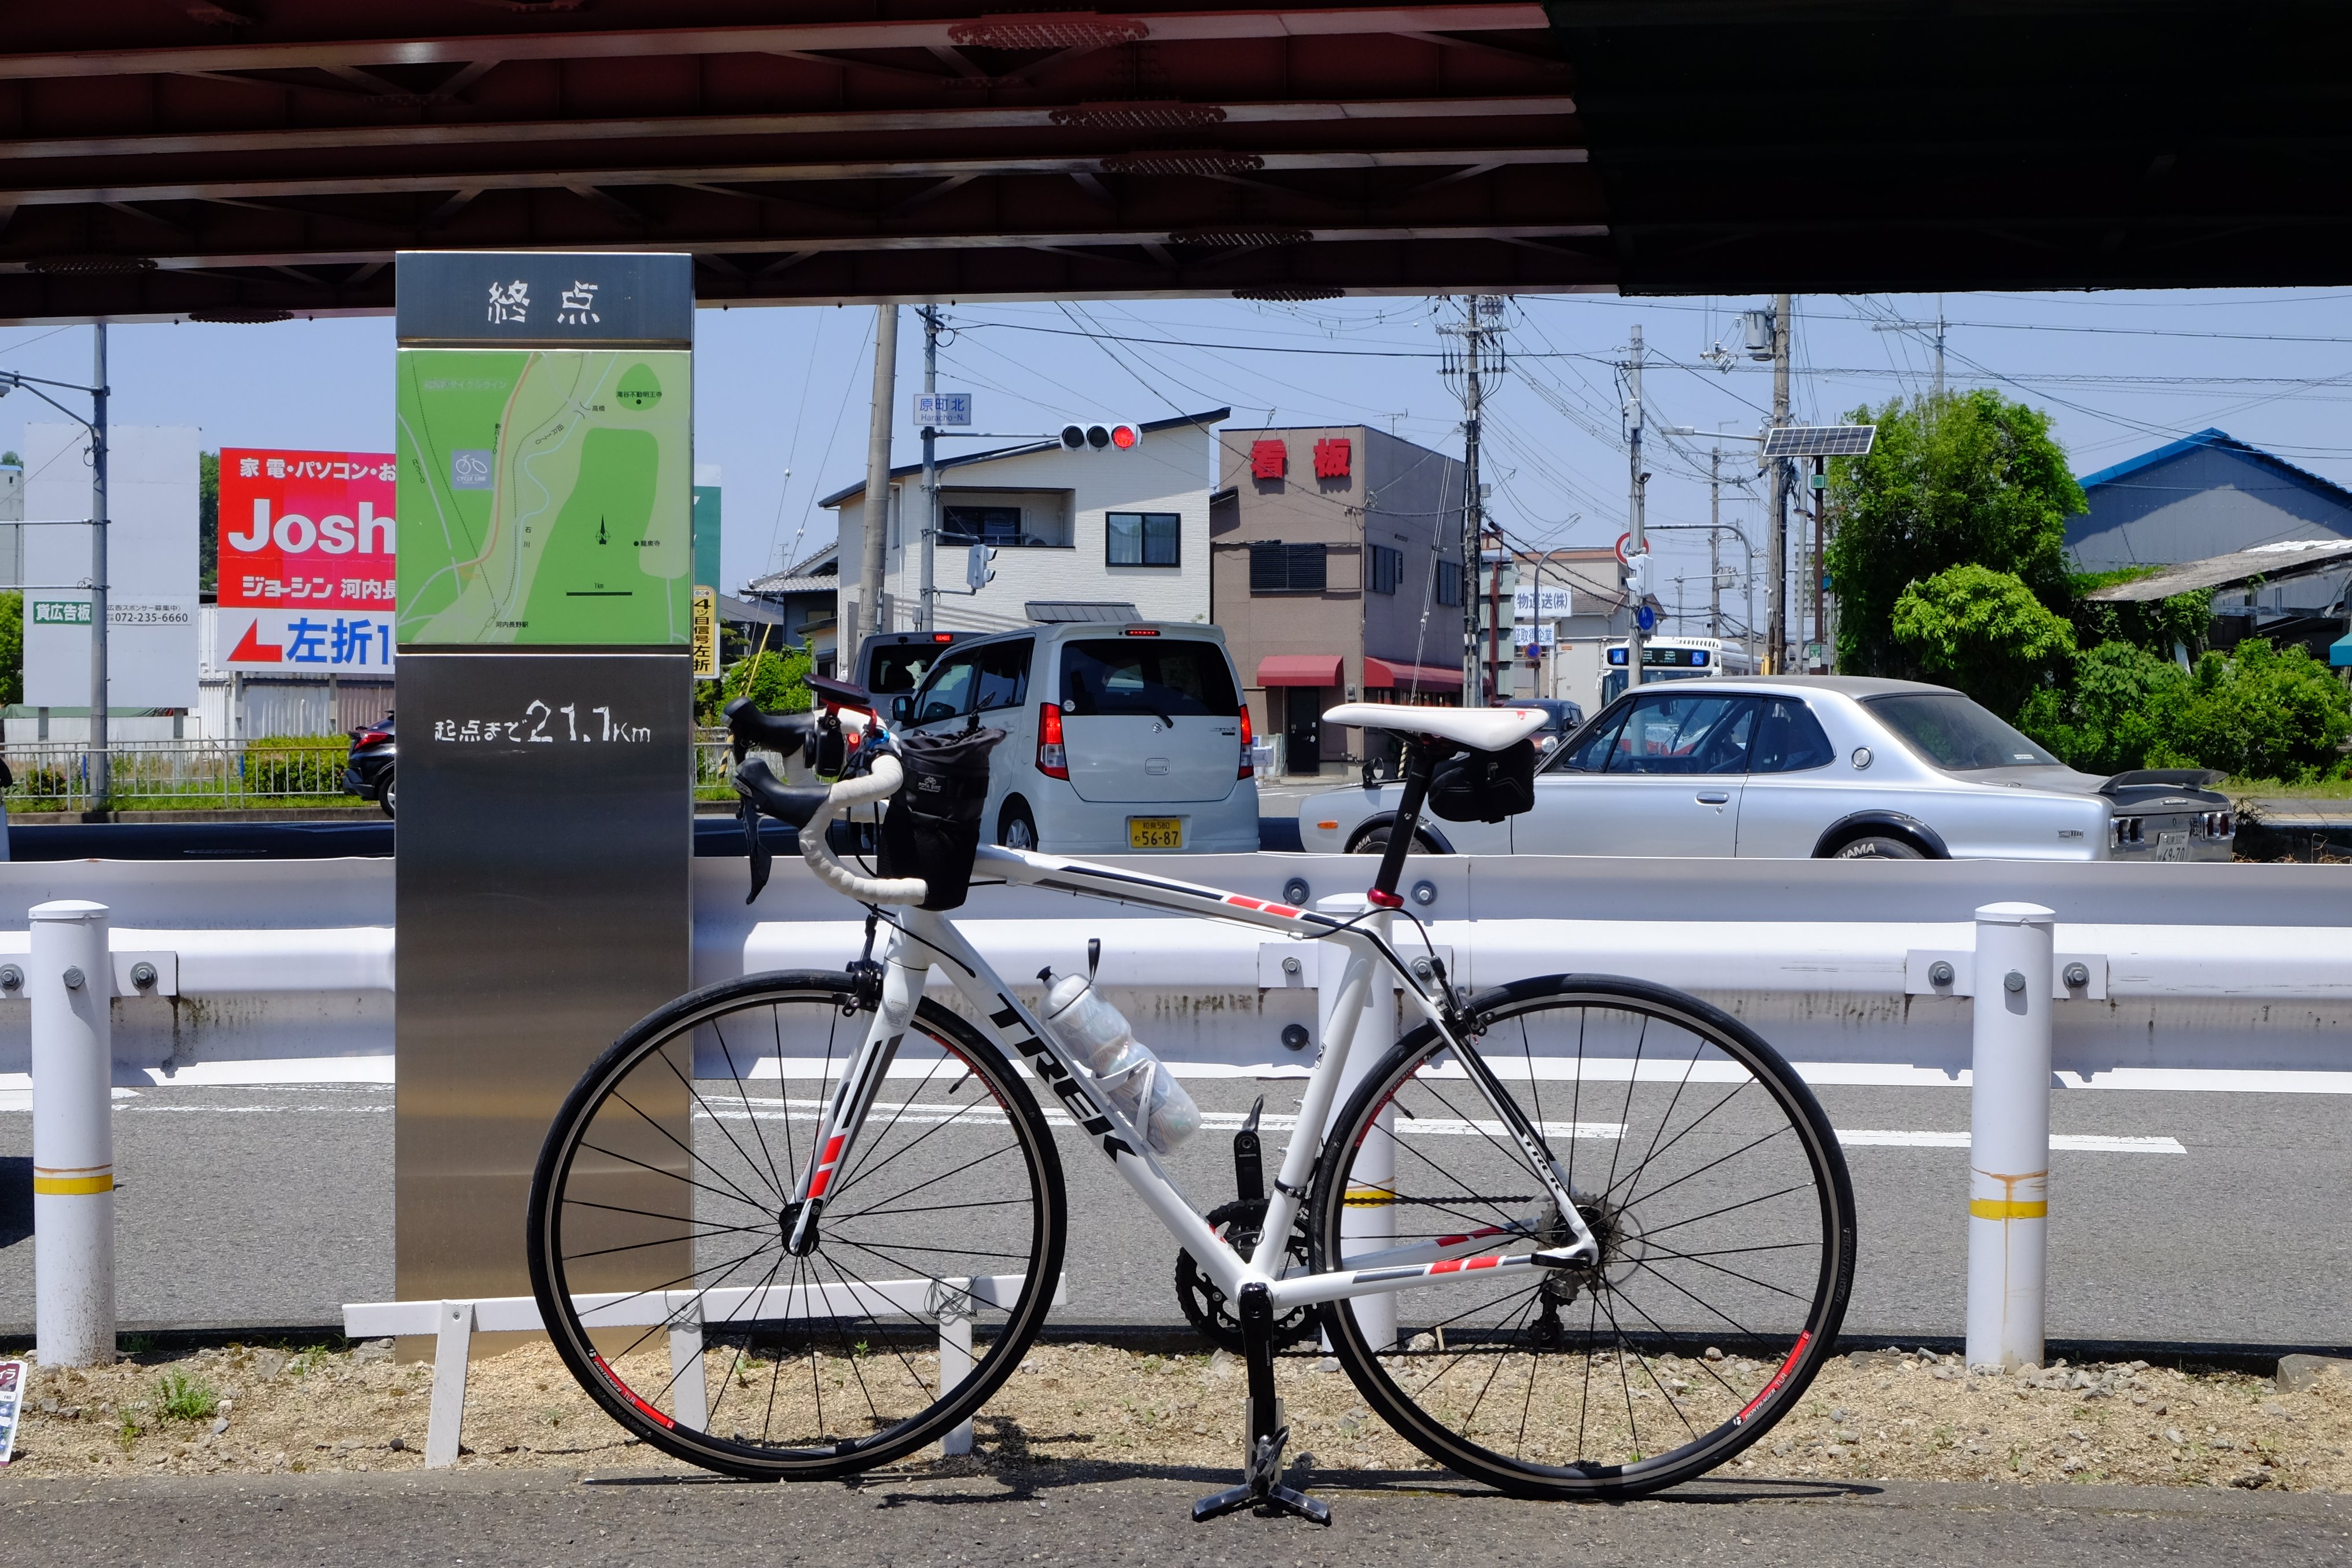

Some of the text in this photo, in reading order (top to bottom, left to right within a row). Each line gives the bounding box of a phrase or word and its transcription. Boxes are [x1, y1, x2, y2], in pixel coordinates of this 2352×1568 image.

[488, 280, 600, 325] 終点
[920, 398, 965, 411] 原町北
[1250, 439, 1350, 479] 看板
[228, 499, 396, 554] Josh
[242, 576, 396, 599] ジョーシン 河内長
[1515, 592, 1567, 609] 物運送(株)
[36, 603, 91, 621] 貸広告板
[115, 613, 188, 623] 072-235-6660
[286, 617, 396, 665] 左折1
[1142, 831, 1179, 845] 56-87
[1353, 835, 1371, 853] AMA
[989, 992, 1139, 1164] TREK
[1525, 1136, 1563, 1192] TREK
[1775, 1372, 1788, 1387] TLR
[623, 1390, 636, 1405] TLR
